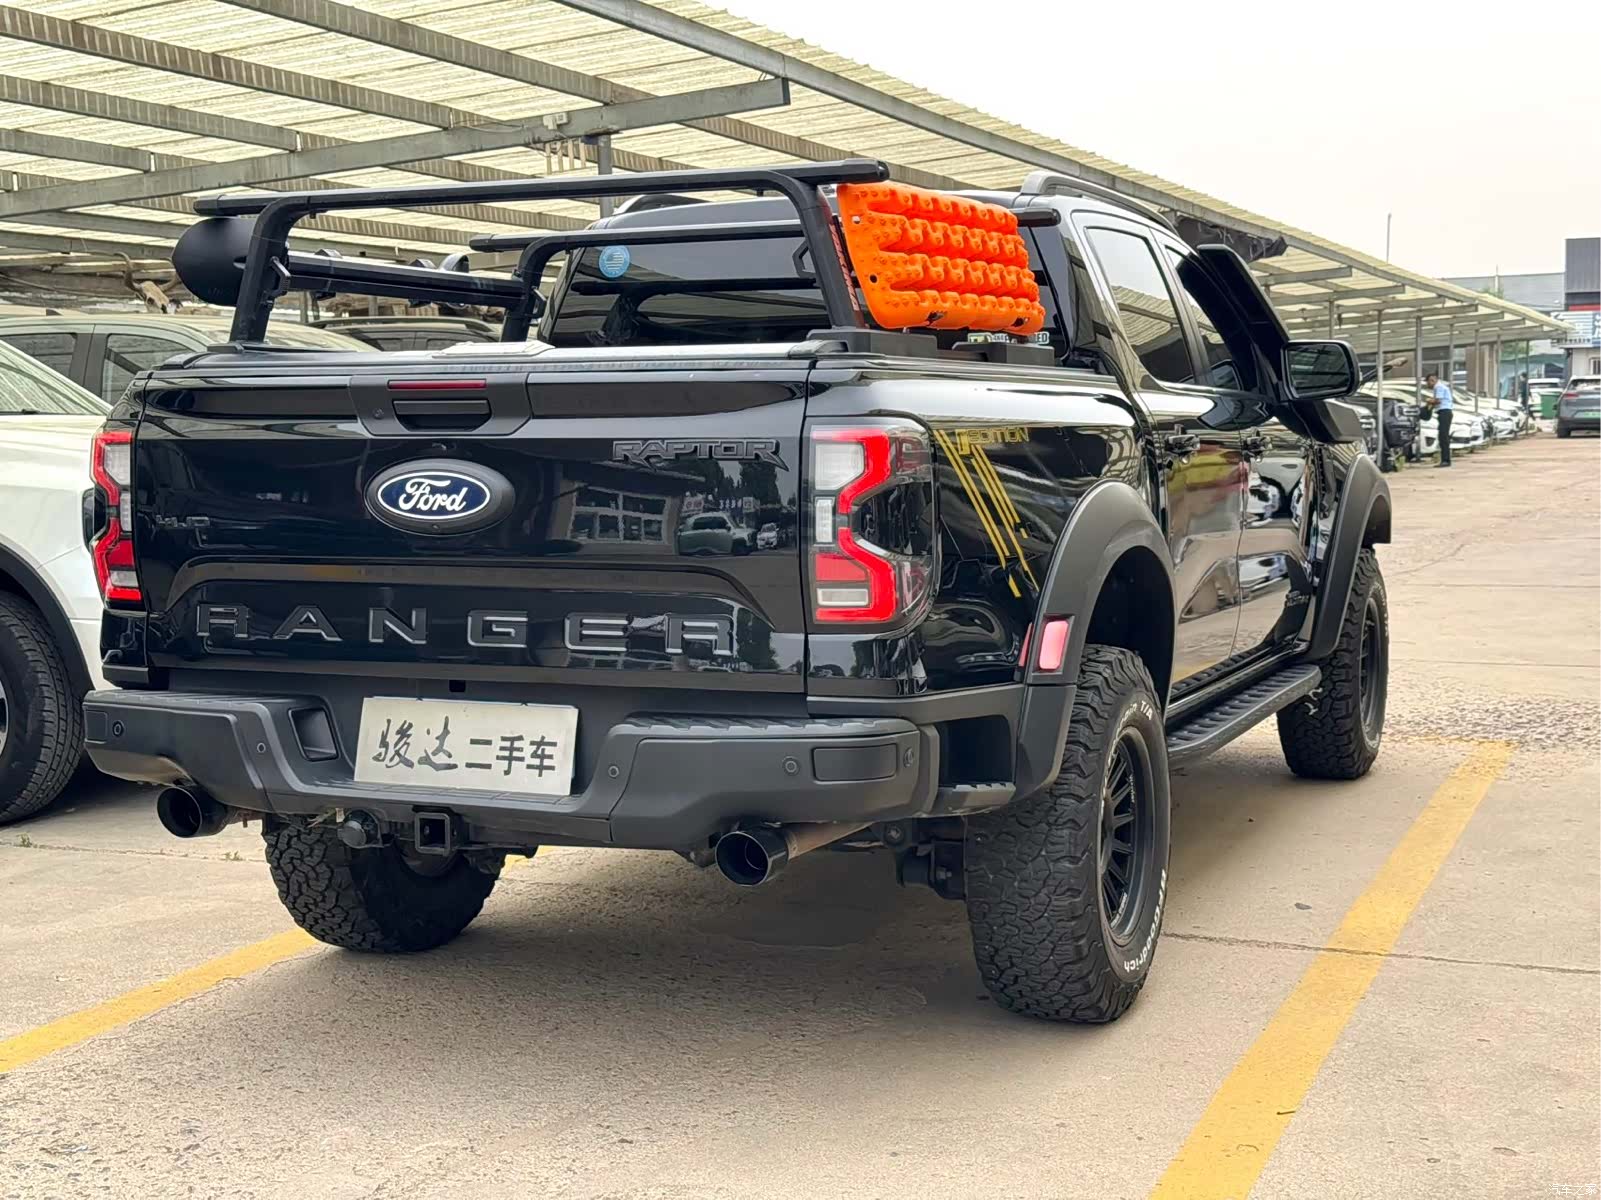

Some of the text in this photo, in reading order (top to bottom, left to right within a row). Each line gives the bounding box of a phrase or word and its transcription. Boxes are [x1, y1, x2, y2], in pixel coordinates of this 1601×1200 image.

[612, 438, 790, 472] RAPTOR
[398, 477, 469, 512] Ford
[196, 603, 734, 656] RANGER
